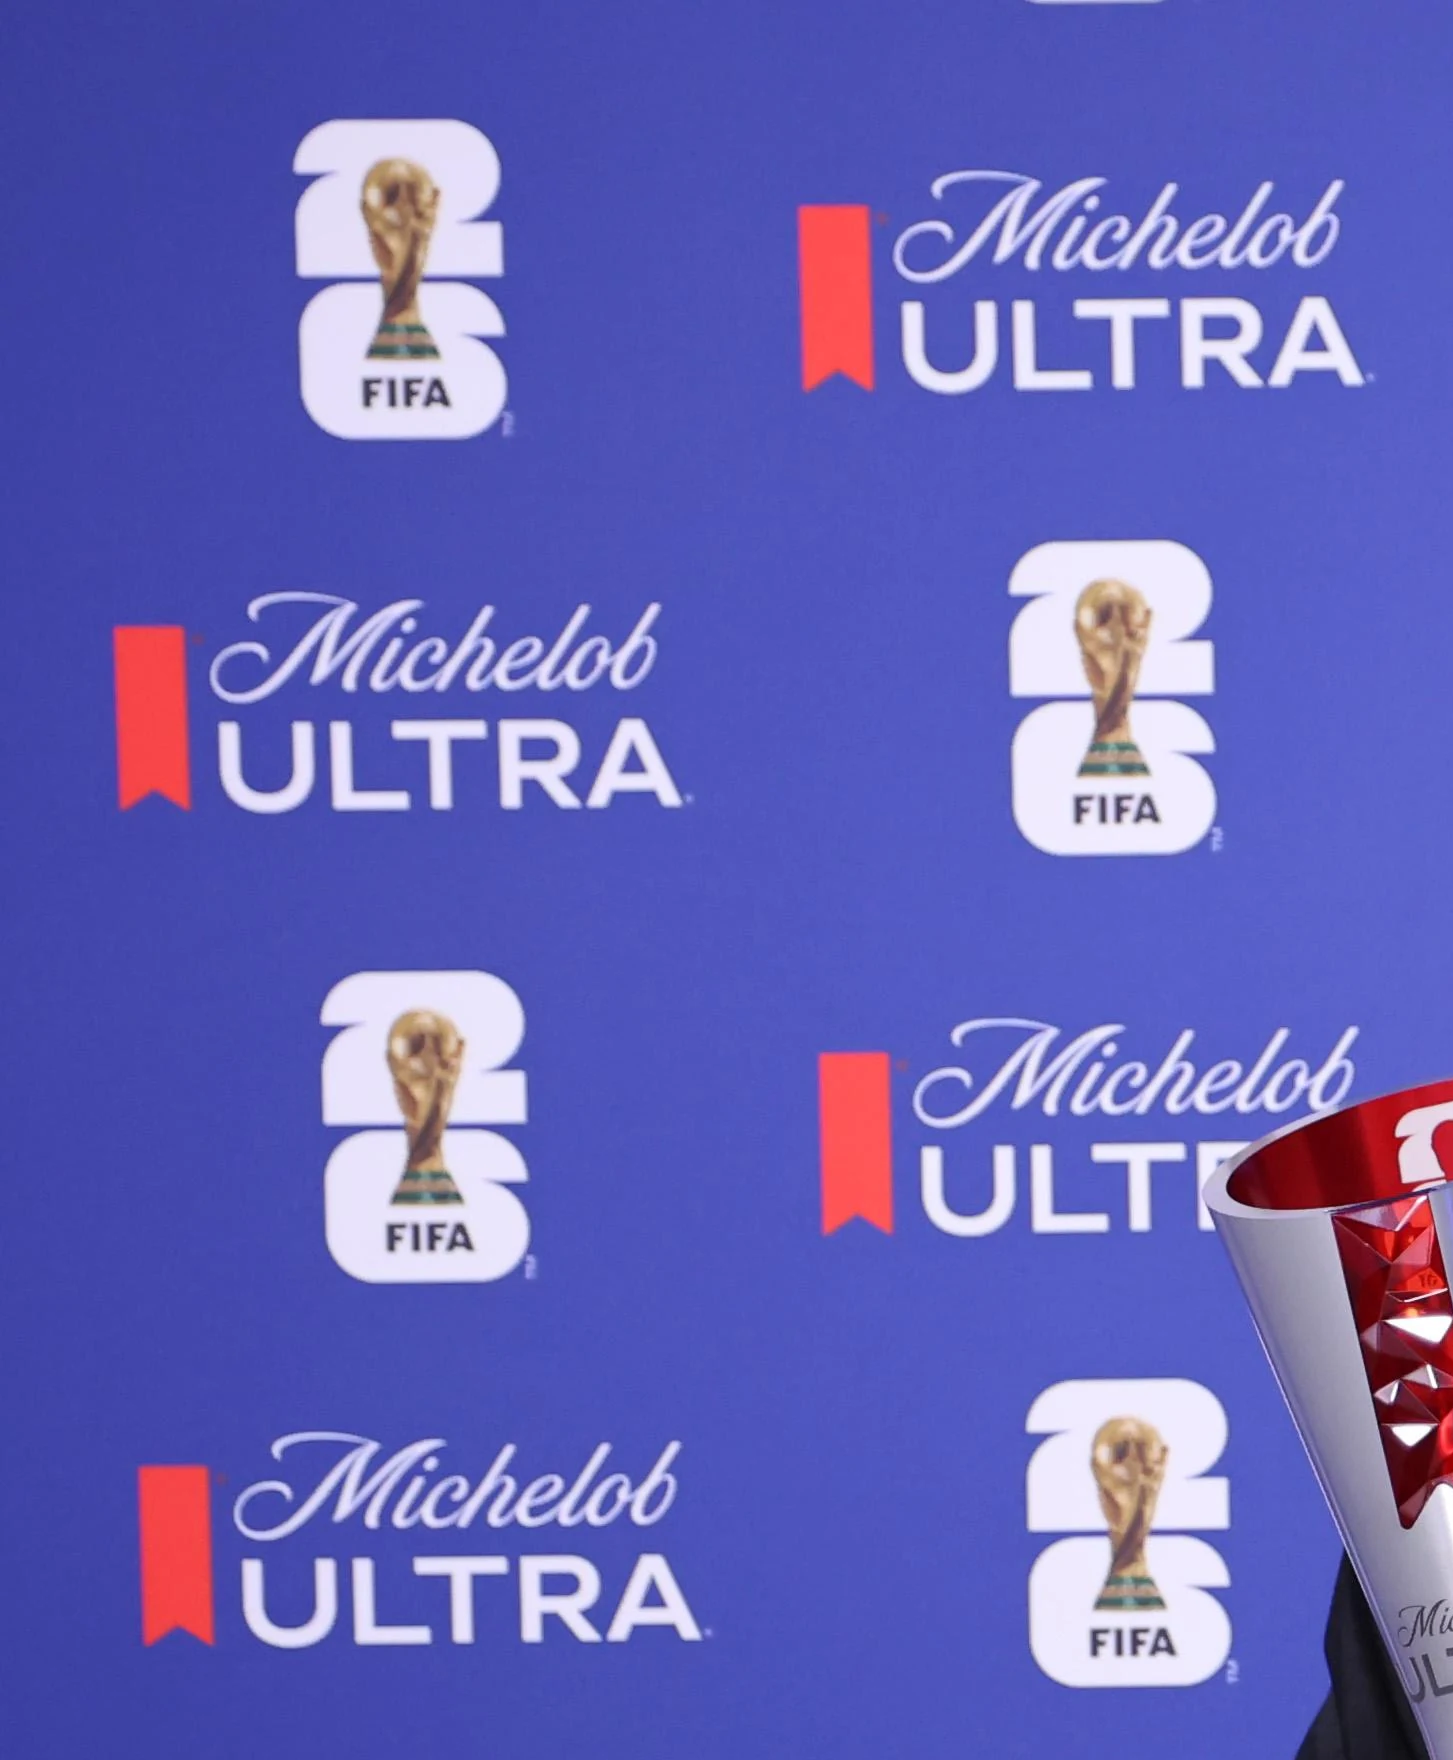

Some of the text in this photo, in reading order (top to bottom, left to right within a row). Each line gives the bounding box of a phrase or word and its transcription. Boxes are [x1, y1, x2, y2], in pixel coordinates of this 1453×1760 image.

[894, 171, 1343, 283] Michelob
[362, 377, 451, 408] FIFA
[901, 296, 1365, 394] ULTRA
[210, 592, 661, 703] Michelob
[218, 718, 683, 813] ULTRA
[1073, 794, 1161, 825] FIFA
[913, 1017, 1360, 1129] Michelob
[920, 1141, 1255, 1237] ULT
[386, 1222, 474, 1252] FIFA
[234, 1432, 680, 1540] Michelob
[241, 1554, 702, 1648] ULTRA
[1090, 1627, 1176, 1657] FIFA
